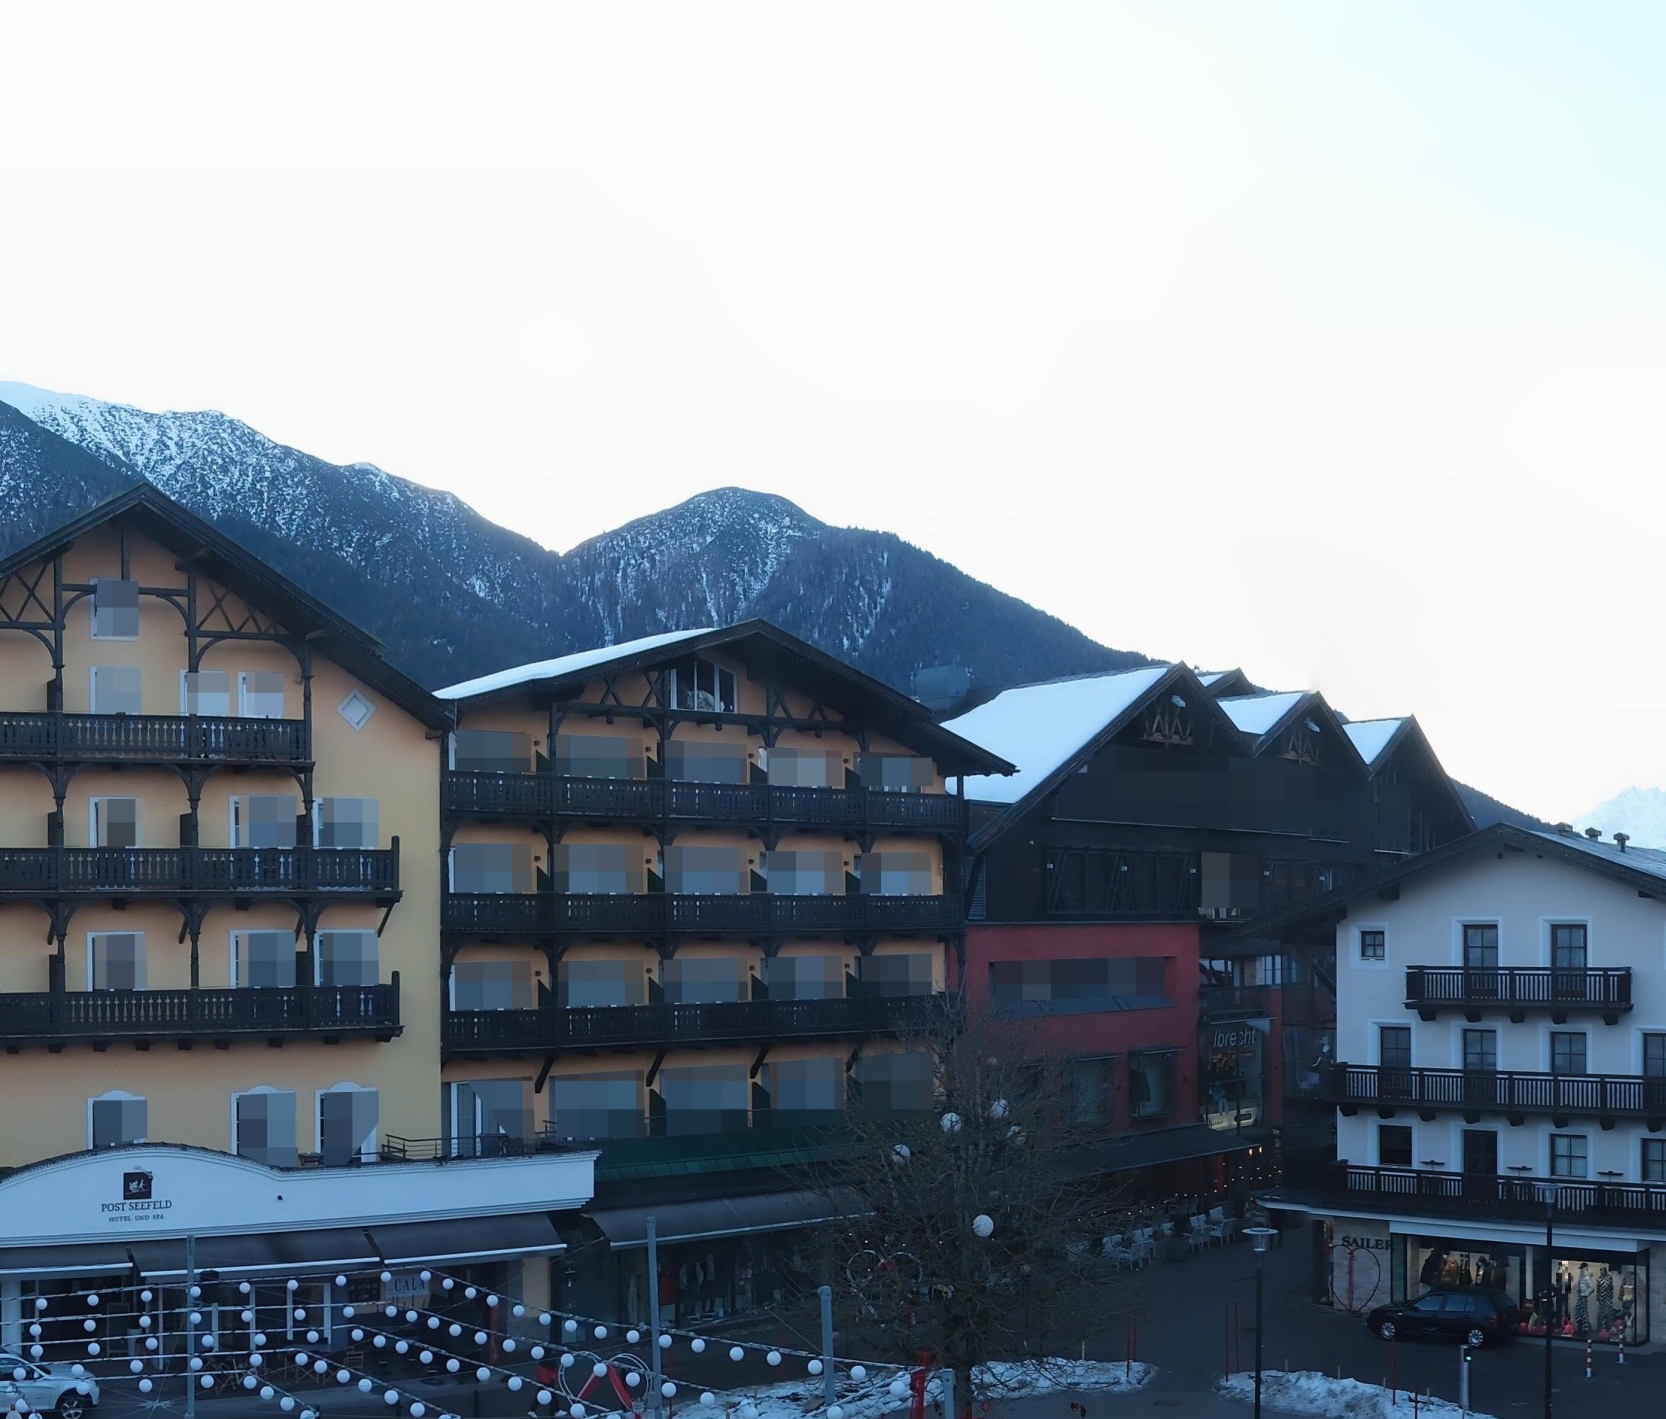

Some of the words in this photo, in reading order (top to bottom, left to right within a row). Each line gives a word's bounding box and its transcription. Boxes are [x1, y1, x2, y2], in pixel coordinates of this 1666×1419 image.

[101, 1202, 126, 1213] POST
[129, 1200, 172, 1211] SEEFELD
[109, 1215, 132, 1223] HOTEL
